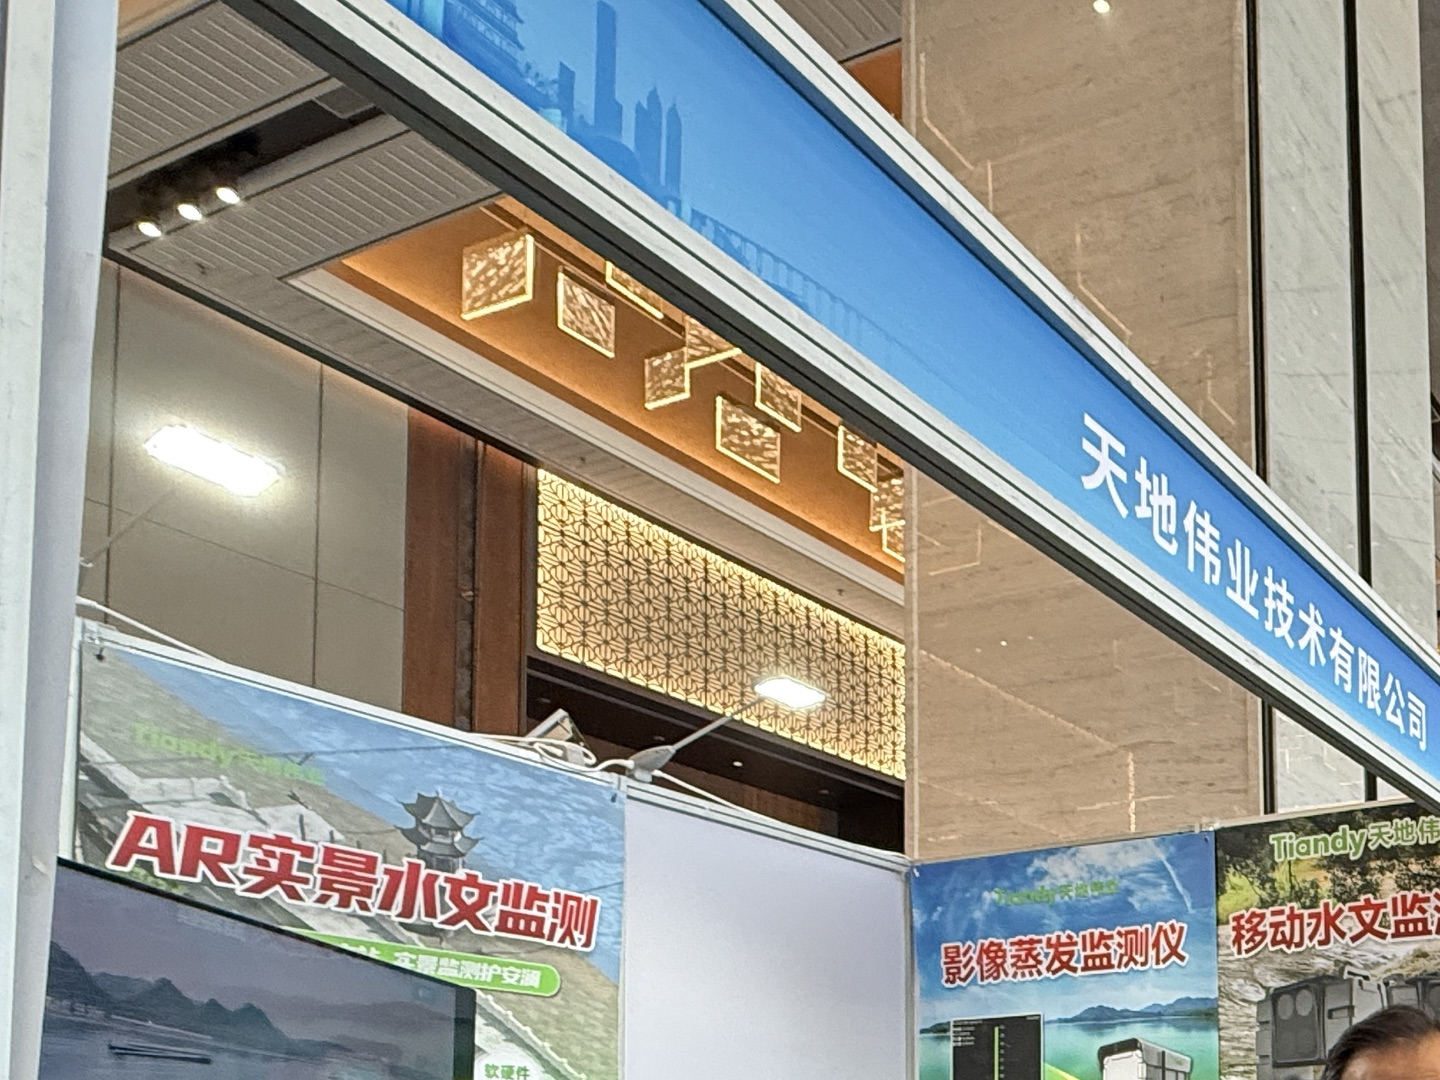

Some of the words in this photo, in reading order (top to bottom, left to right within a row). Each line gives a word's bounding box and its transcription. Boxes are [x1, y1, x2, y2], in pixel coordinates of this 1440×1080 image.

[1080, 412, 1428, 752] 天地伟业技术有限公司
[108, 813, 599, 950] AR实景水文监测
[1270, 825, 1367, 861] Tiandy
[942, 921, 1188, 986] 影像蒸发监测仪
